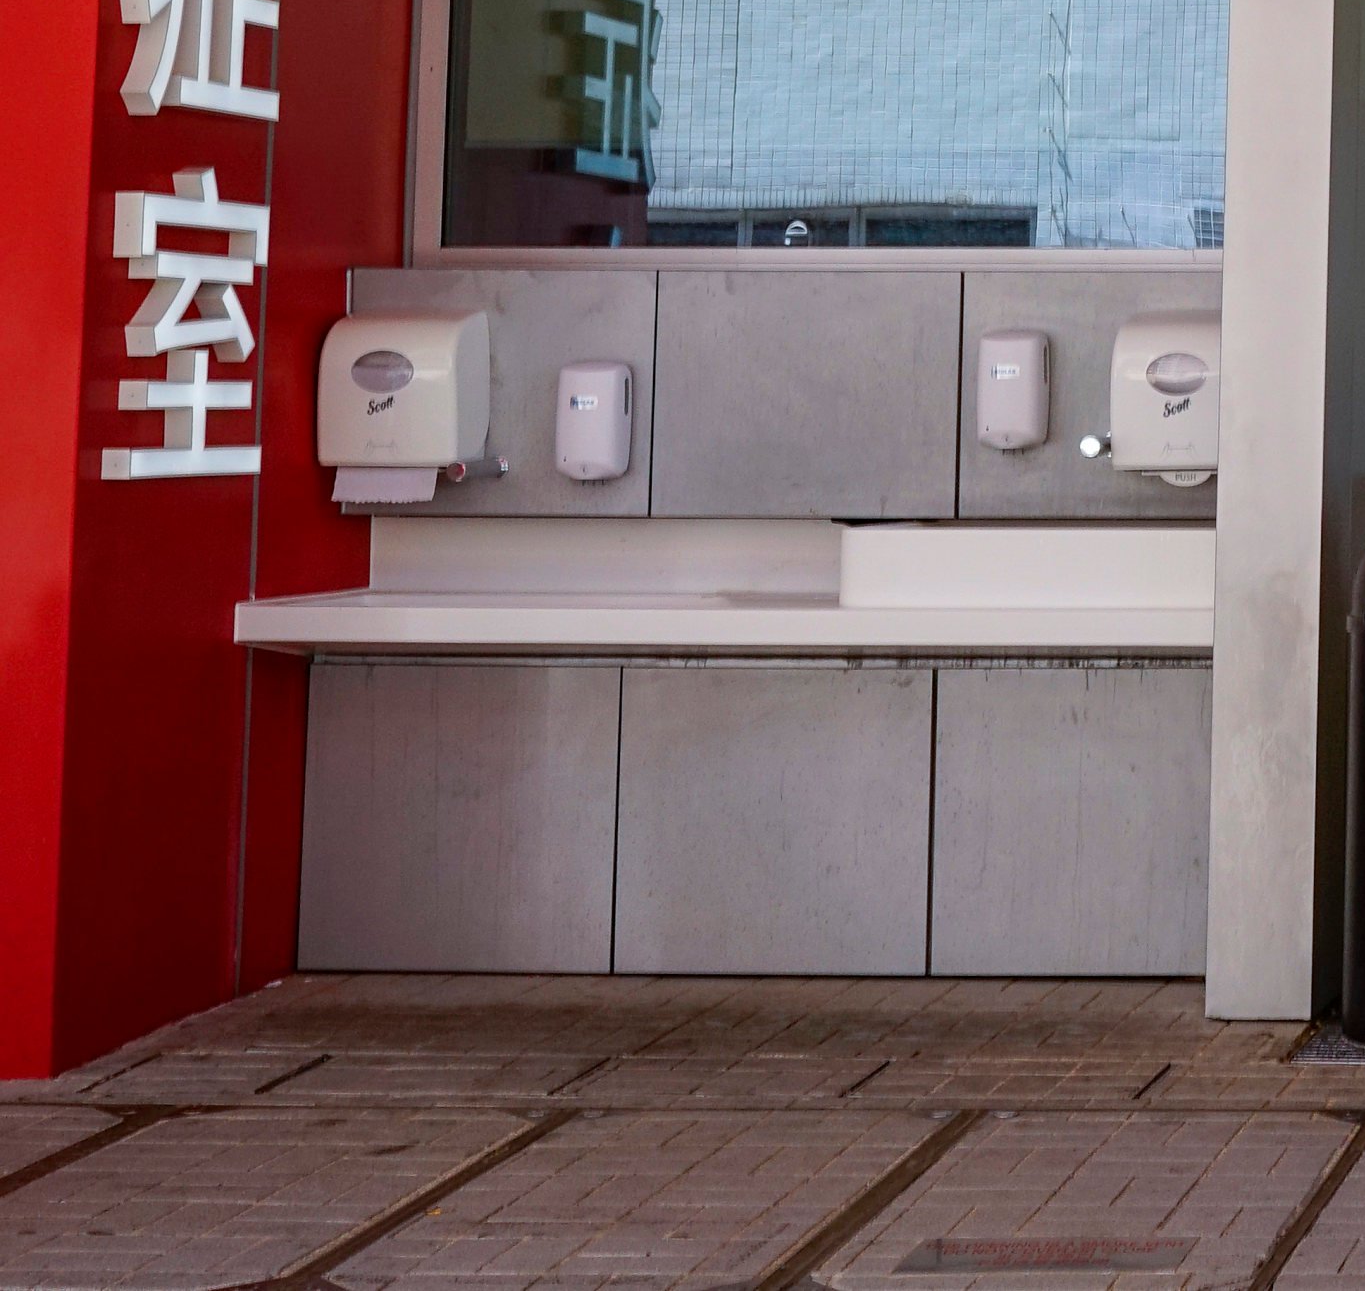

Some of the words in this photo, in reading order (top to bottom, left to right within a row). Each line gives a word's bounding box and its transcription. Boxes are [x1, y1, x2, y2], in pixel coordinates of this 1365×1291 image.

[367, 395, 395, 416] Scott
[1163, 397, 1191, 418] Scott
[1175, 473, 1197, 482] PUSH
